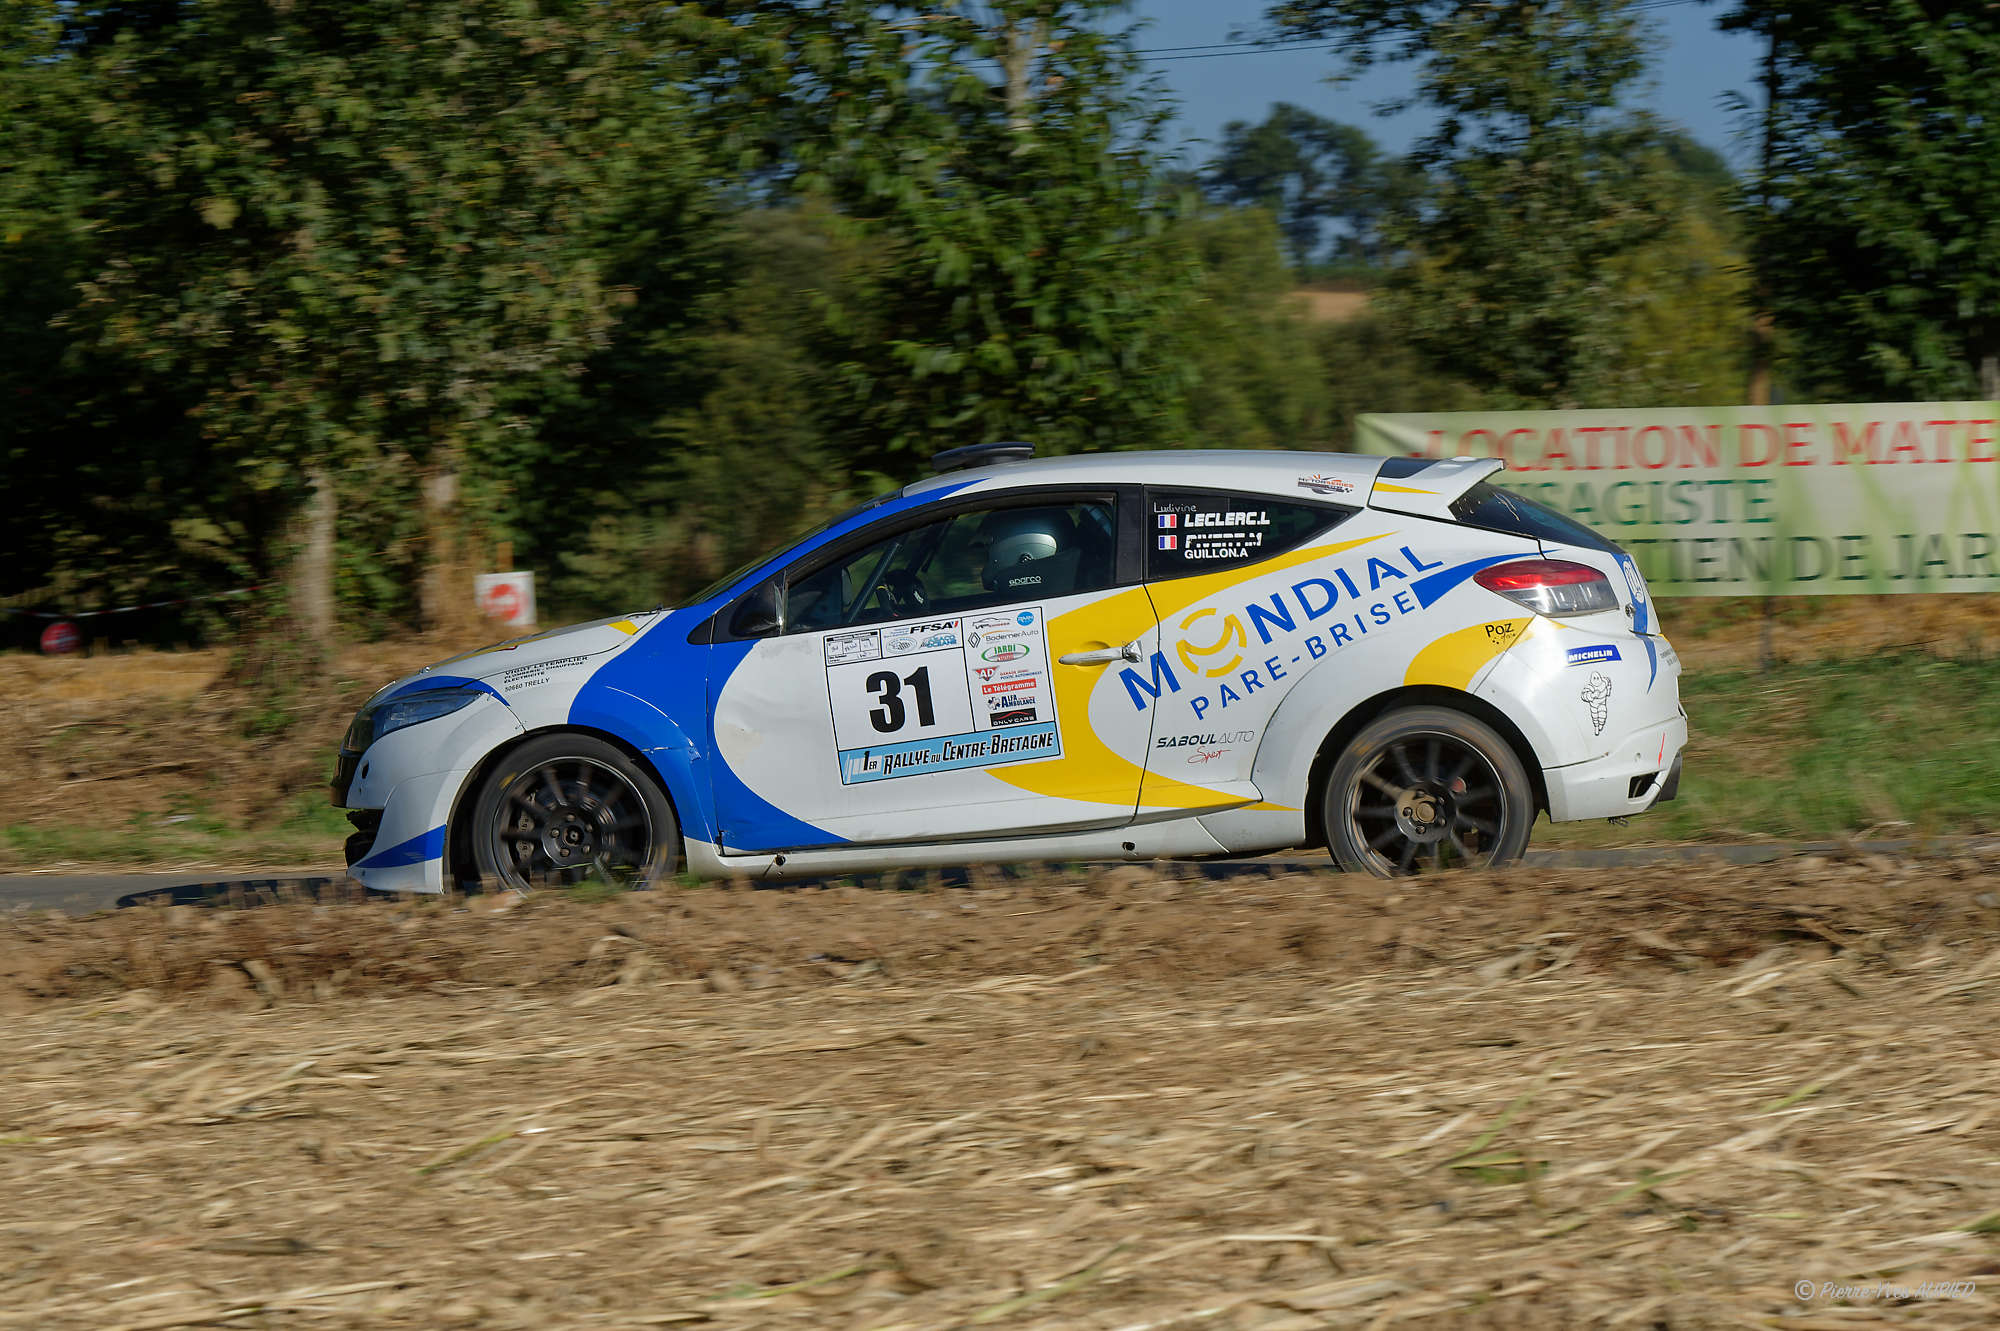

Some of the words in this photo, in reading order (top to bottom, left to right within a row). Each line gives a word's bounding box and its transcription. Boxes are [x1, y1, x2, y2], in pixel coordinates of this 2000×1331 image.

[1737, 423, 1815, 467] DE
[1153, 502, 1198, 513] Ludivine
[1184, 511, 1271, 528] LECLERC.L
[1184, 548, 1248, 560] GUILLON.A
[1790, 535, 1870, 581] DE
[909, 621, 953, 635] FFSA
[1190, 590, 1415, 721] PARE-BRISE
[1568, 649, 1614, 662] MICHELIN
[979, 668, 994, 678] AD
[984, 686, 992, 694] Le
[866, 666, 936, 733] 31
[883, 749, 930, 776] RALLYE
[942, 732, 1054, 761] CENTRE-BRETAGNE
